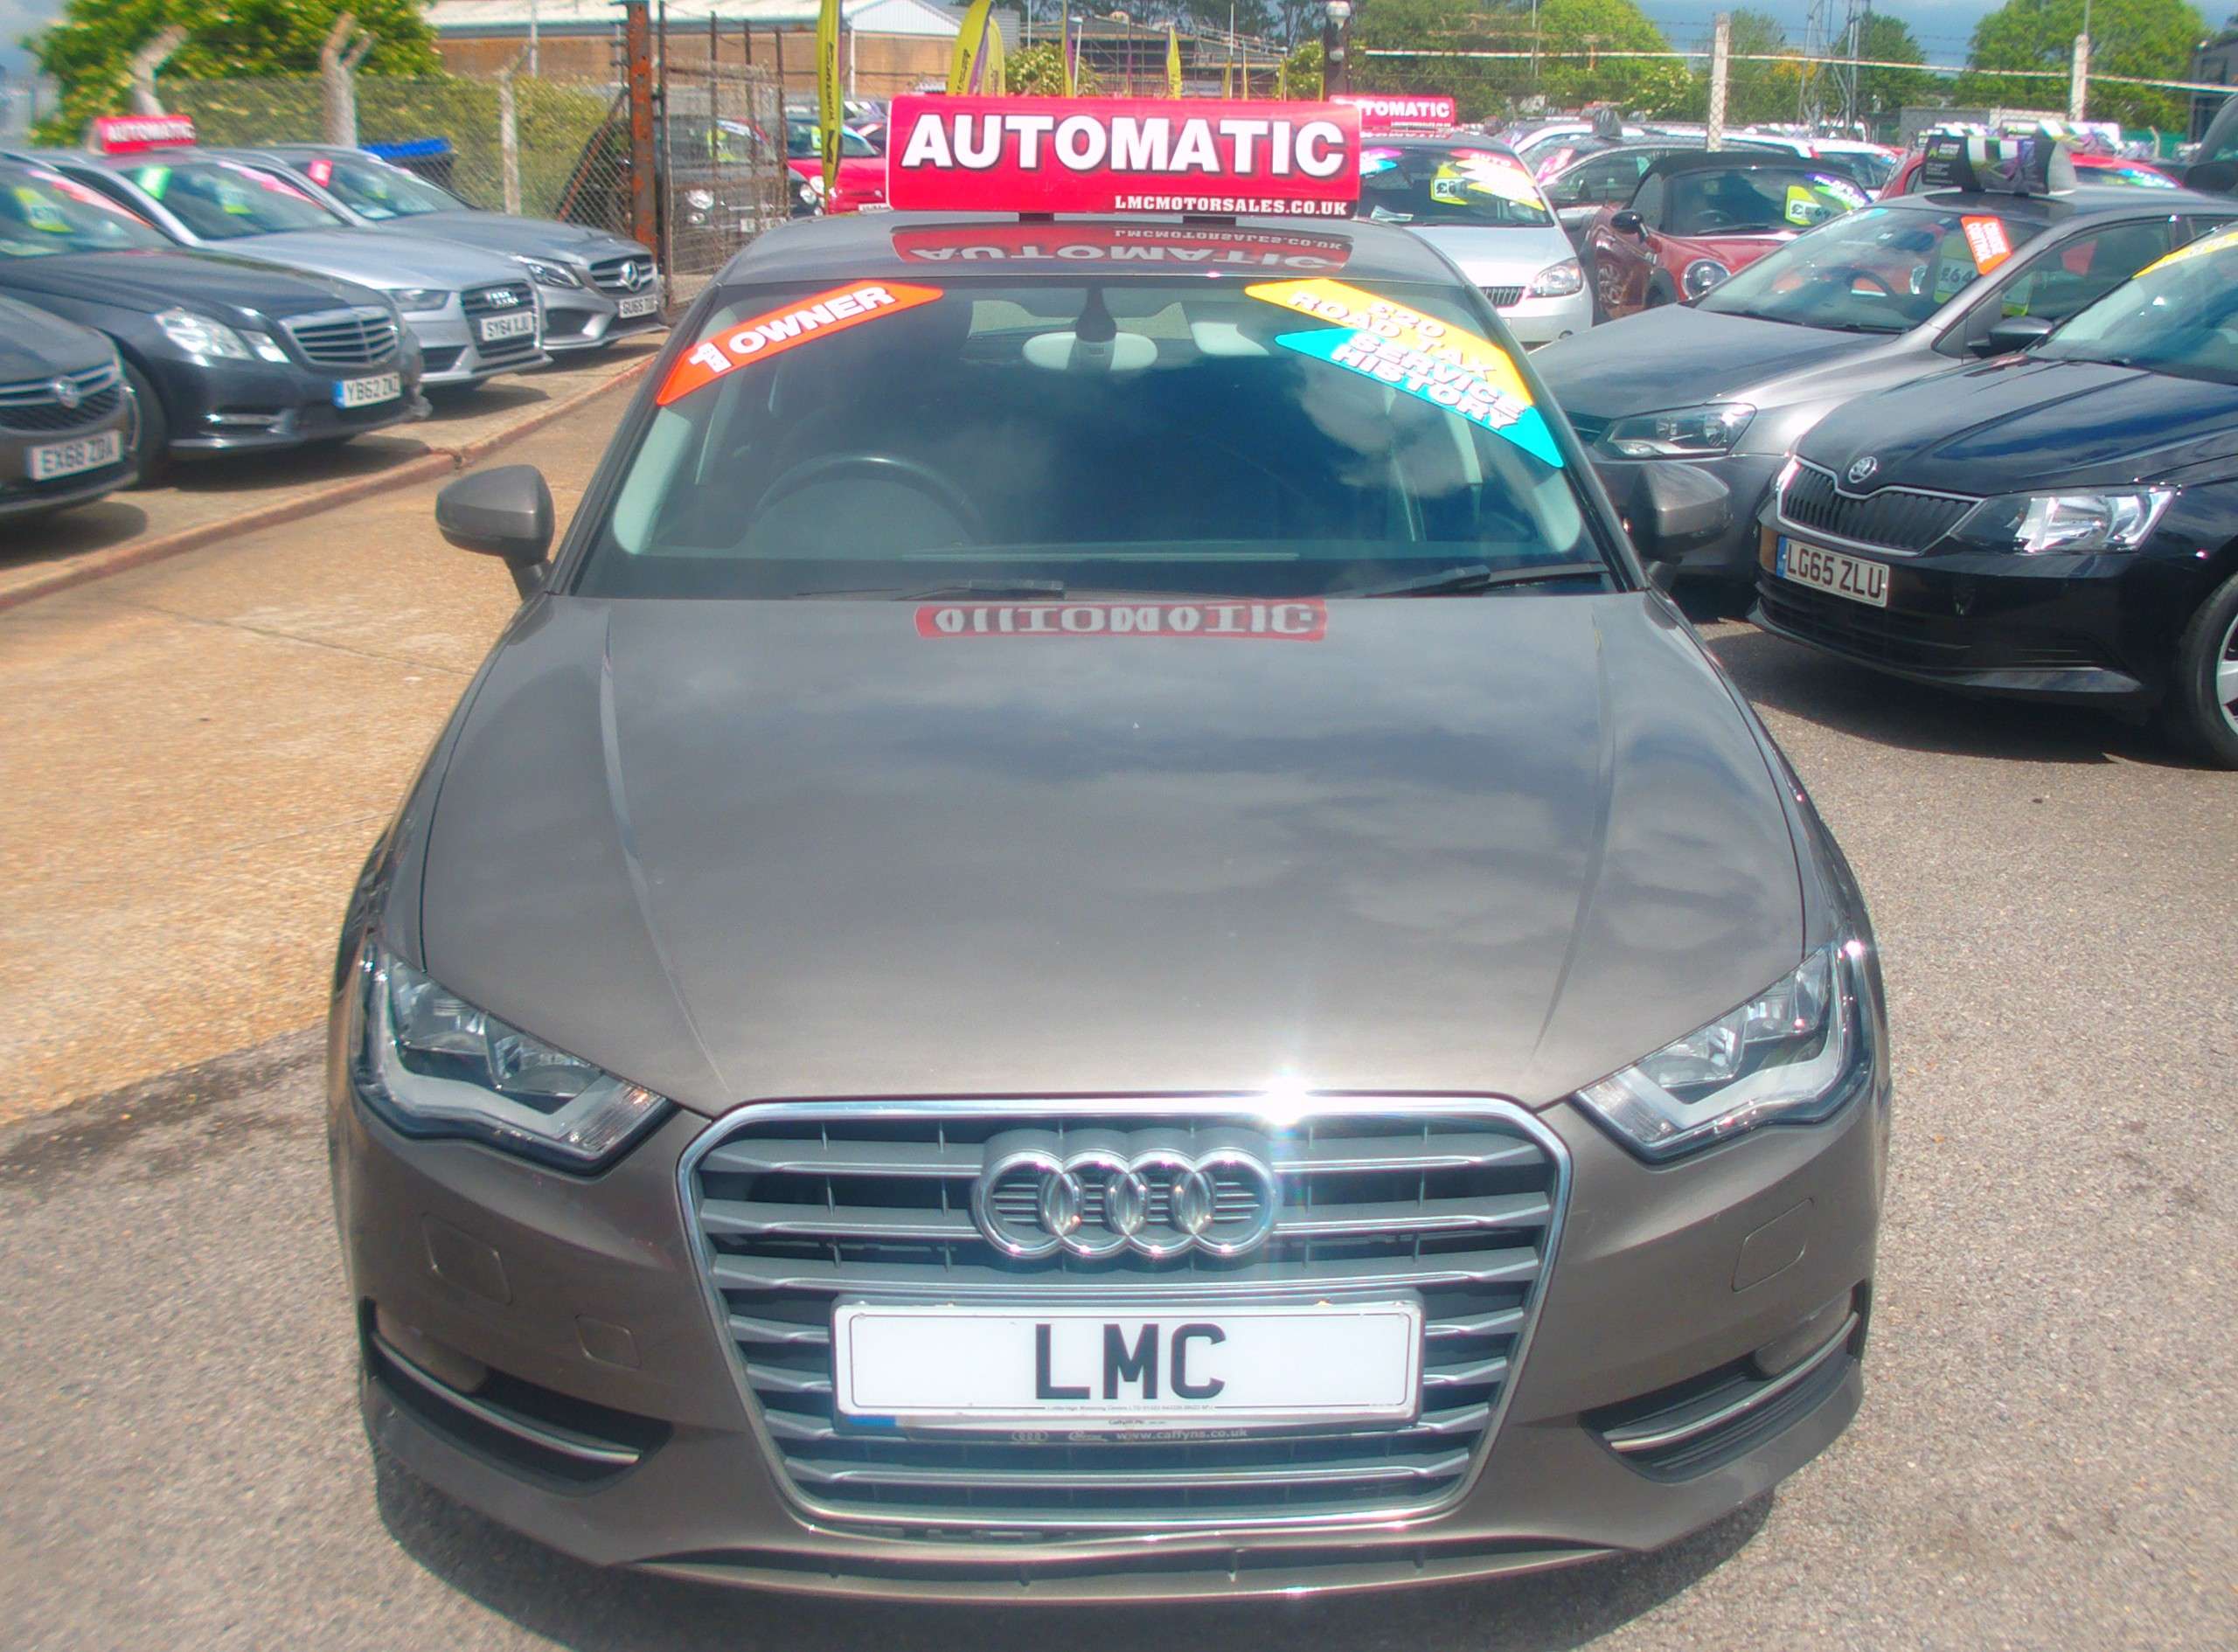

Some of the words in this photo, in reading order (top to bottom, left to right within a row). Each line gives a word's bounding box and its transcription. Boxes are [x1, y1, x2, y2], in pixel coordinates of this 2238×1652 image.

[901, 115, 1346, 177] AUTOMATIC
[1115, 195, 1347, 215] LMCMOTORSALES.CO.UK
[689, 342, 732, 373] 1
[728, 286, 896, 354] OWNER
[1287, 290, 1403, 340] ROAD
[1414, 334, 1497, 382] TAX
[1366, 300, 1446, 339] £20
[1330, 344, 1523, 430] HISTORY
[1345, 331, 1534, 420] SERVICE
[1787, 542, 1835, 587] LG65
[1838, 559, 1883, 600] ZLU
[1034, 1322, 1227, 1401] LMC
